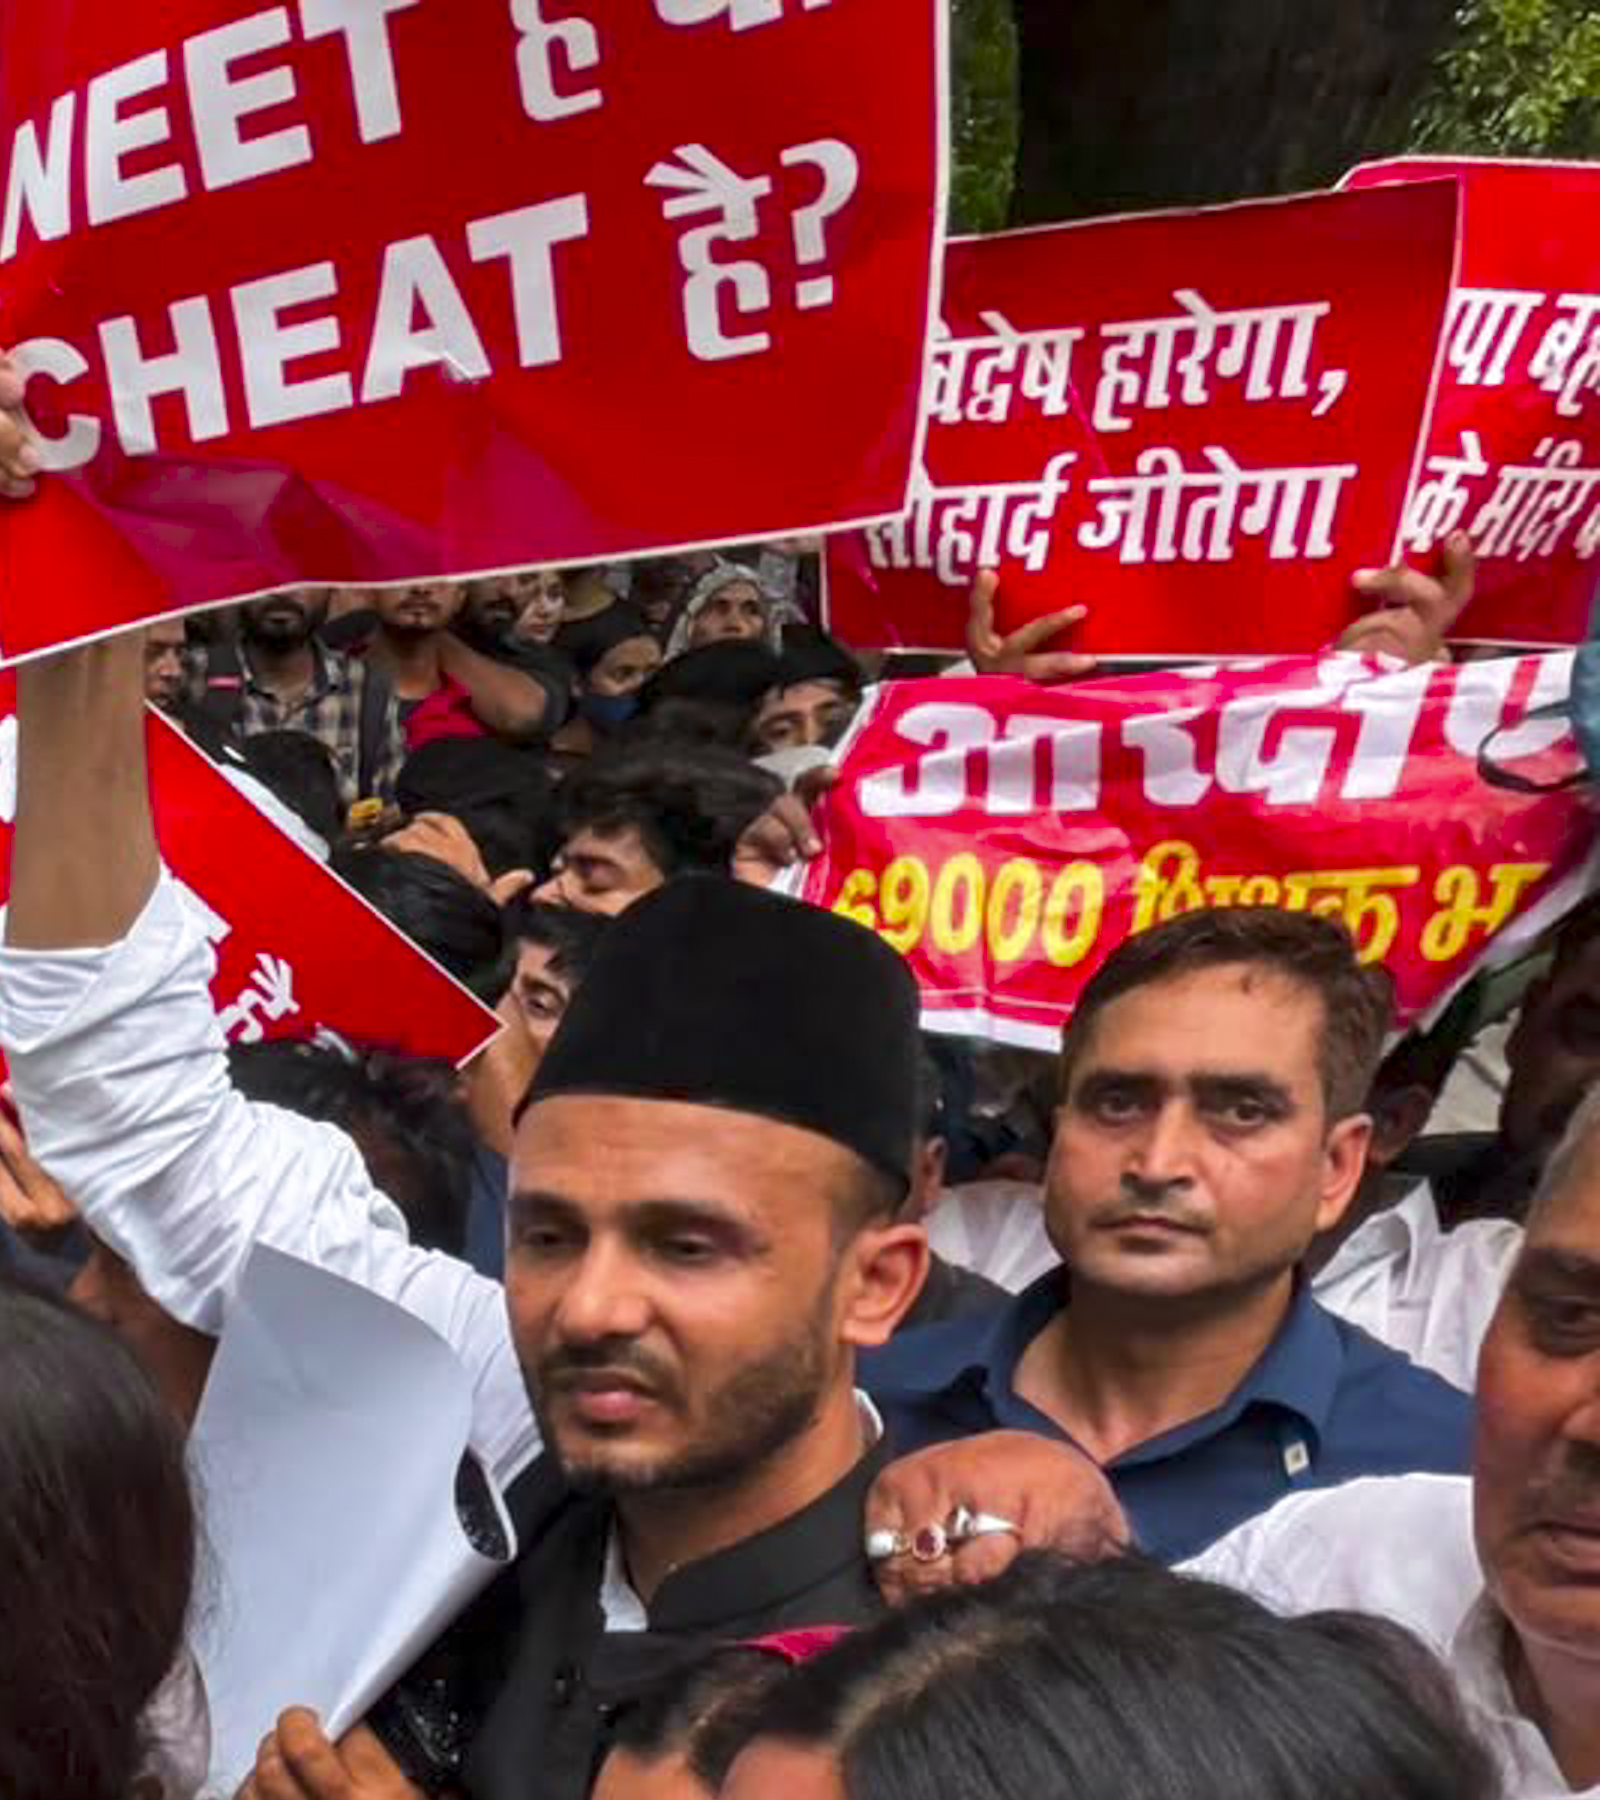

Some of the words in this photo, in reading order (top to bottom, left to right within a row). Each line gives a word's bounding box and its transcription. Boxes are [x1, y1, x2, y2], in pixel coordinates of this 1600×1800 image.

[3, 192, 589, 471] CHEAT
[643, 138, 859, 361] है?
[926, 310, 1085, 424] वद्वेष
[1091, 288, 1349, 432] हारेगा,
[1077, 445, 1358, 564] जीतेगा
[831, 851, 1103, 967] 69000
